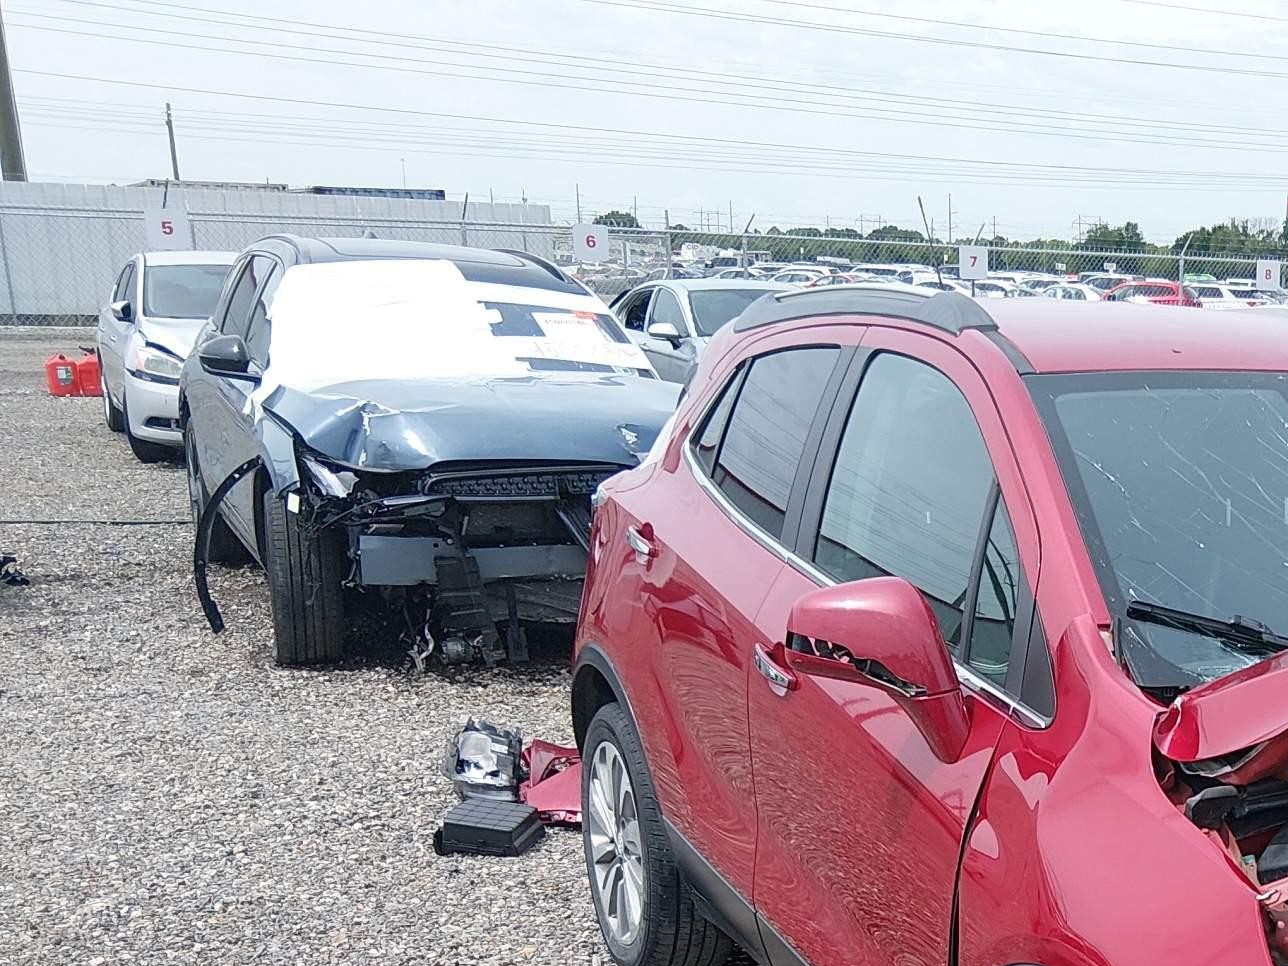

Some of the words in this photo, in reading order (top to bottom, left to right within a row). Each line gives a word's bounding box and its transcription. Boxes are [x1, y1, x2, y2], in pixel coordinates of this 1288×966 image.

[161, 221, 174, 236] 5
[586, 234, 597, 249] 6
[969, 255, 978, 268] 7
[1265, 269, 1272, 280] 8
